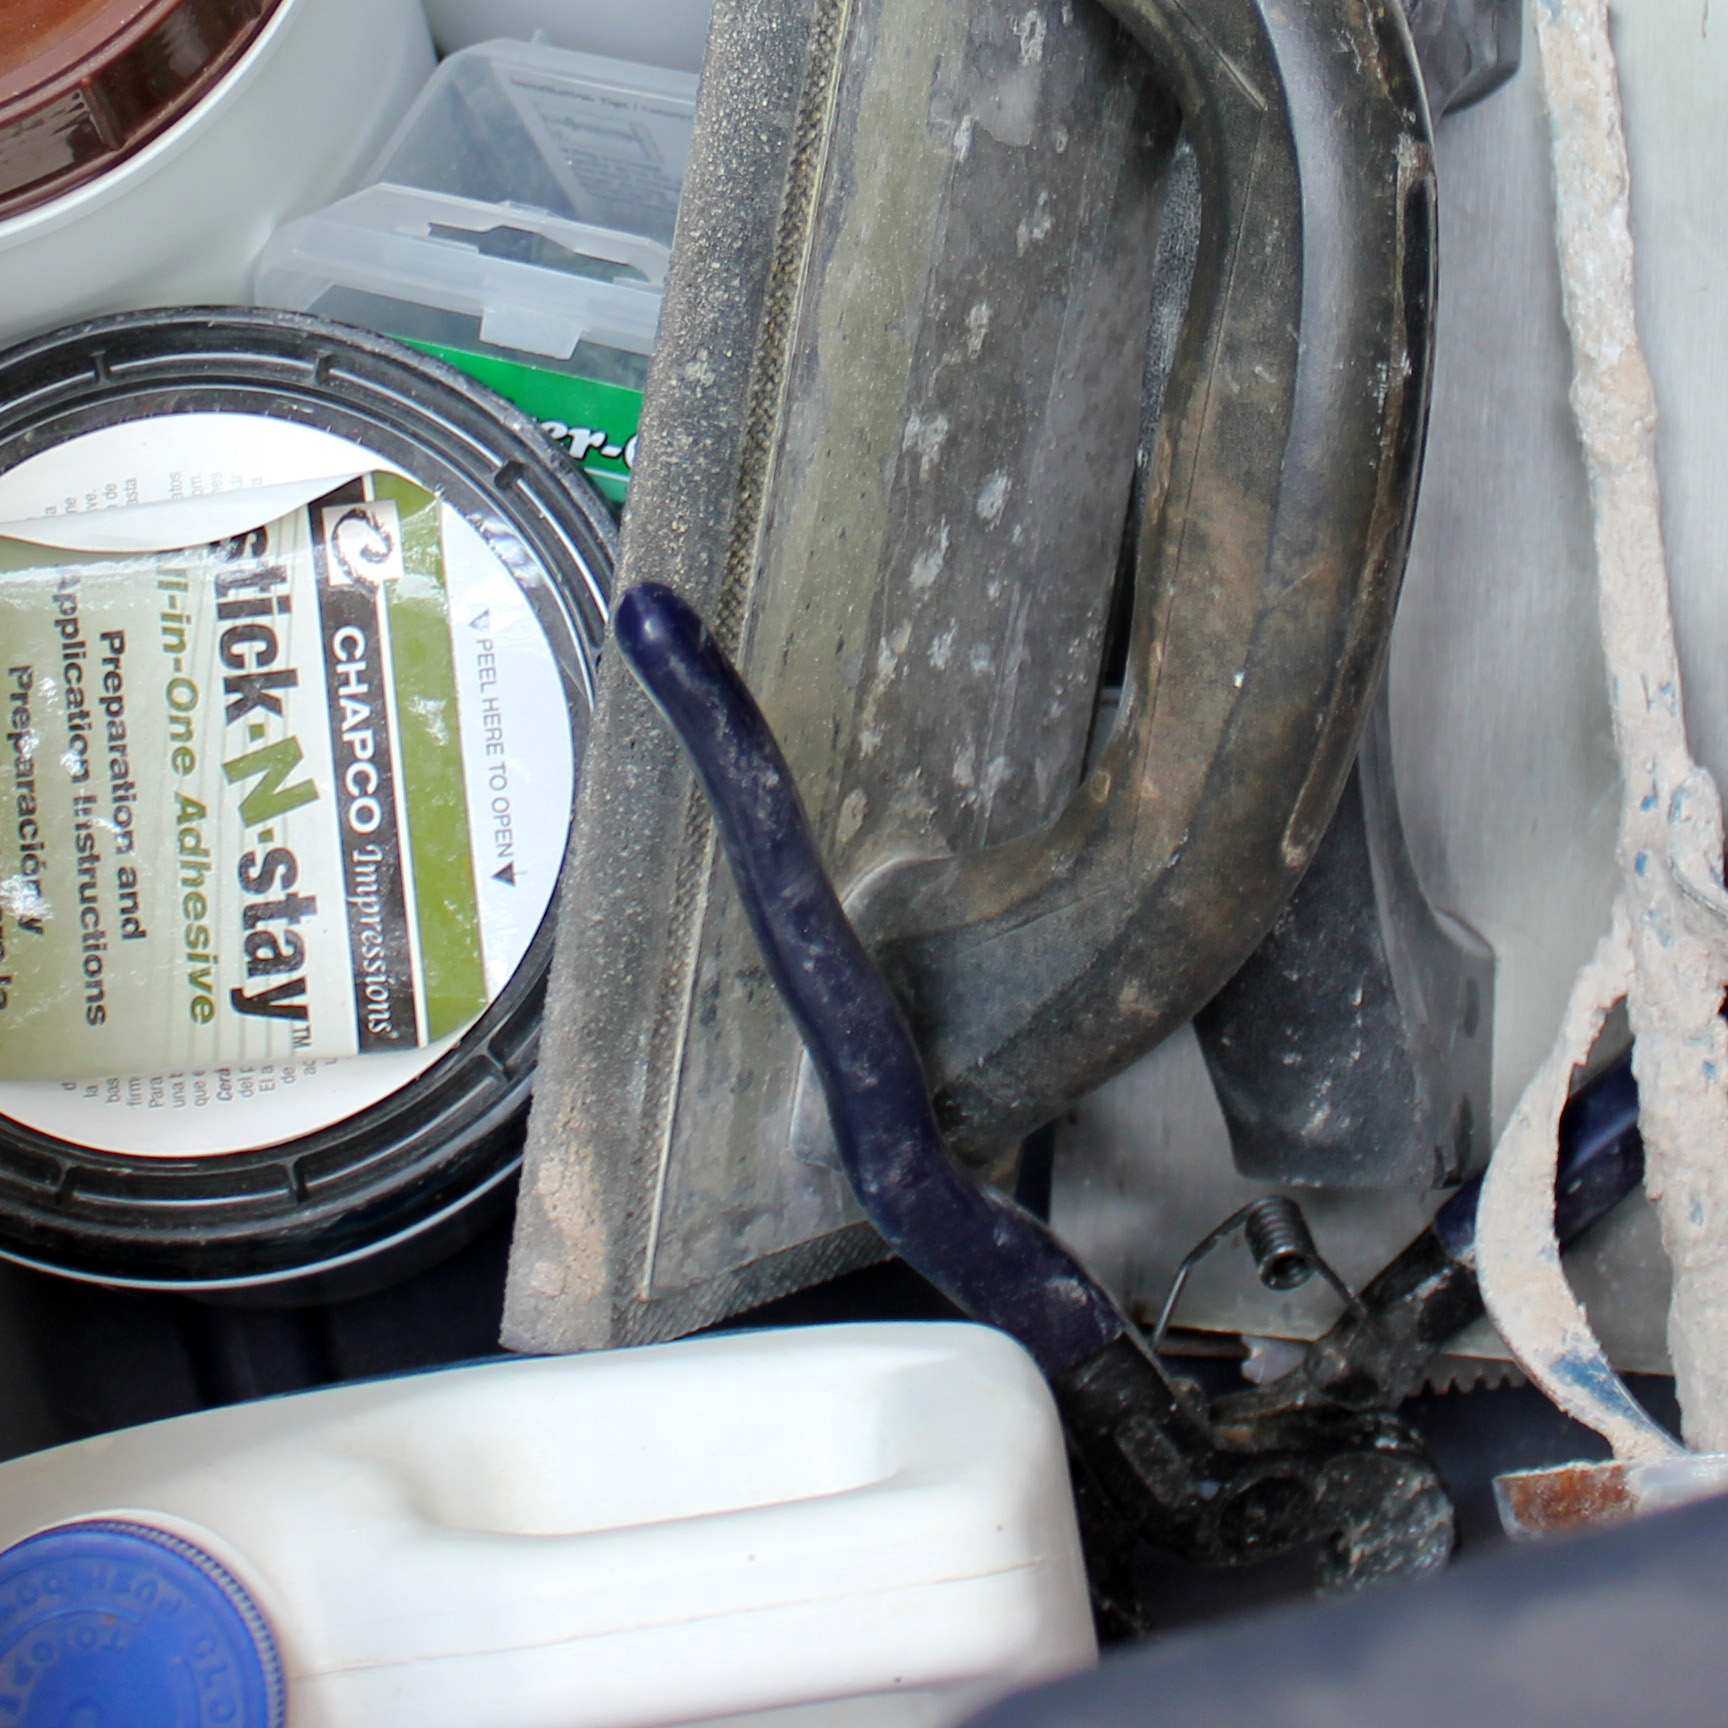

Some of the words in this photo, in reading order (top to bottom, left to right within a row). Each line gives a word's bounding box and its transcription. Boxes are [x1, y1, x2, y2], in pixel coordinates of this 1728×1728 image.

[332, 625, 382, 834] CHAPCO
[476, 639, 495, 693] PEEL
[483, 698, 504, 756] HERE
[52, 572, 92, 784] Application
[73, 795, 107, 1027] Instructions
[99, 630, 137, 855] Preparation
[118, 866, 147, 940] and
[489, 761, 507, 791] TO
[492, 796, 513, 858] OPEN
[175, 791, 219, 1025] Adhesive
